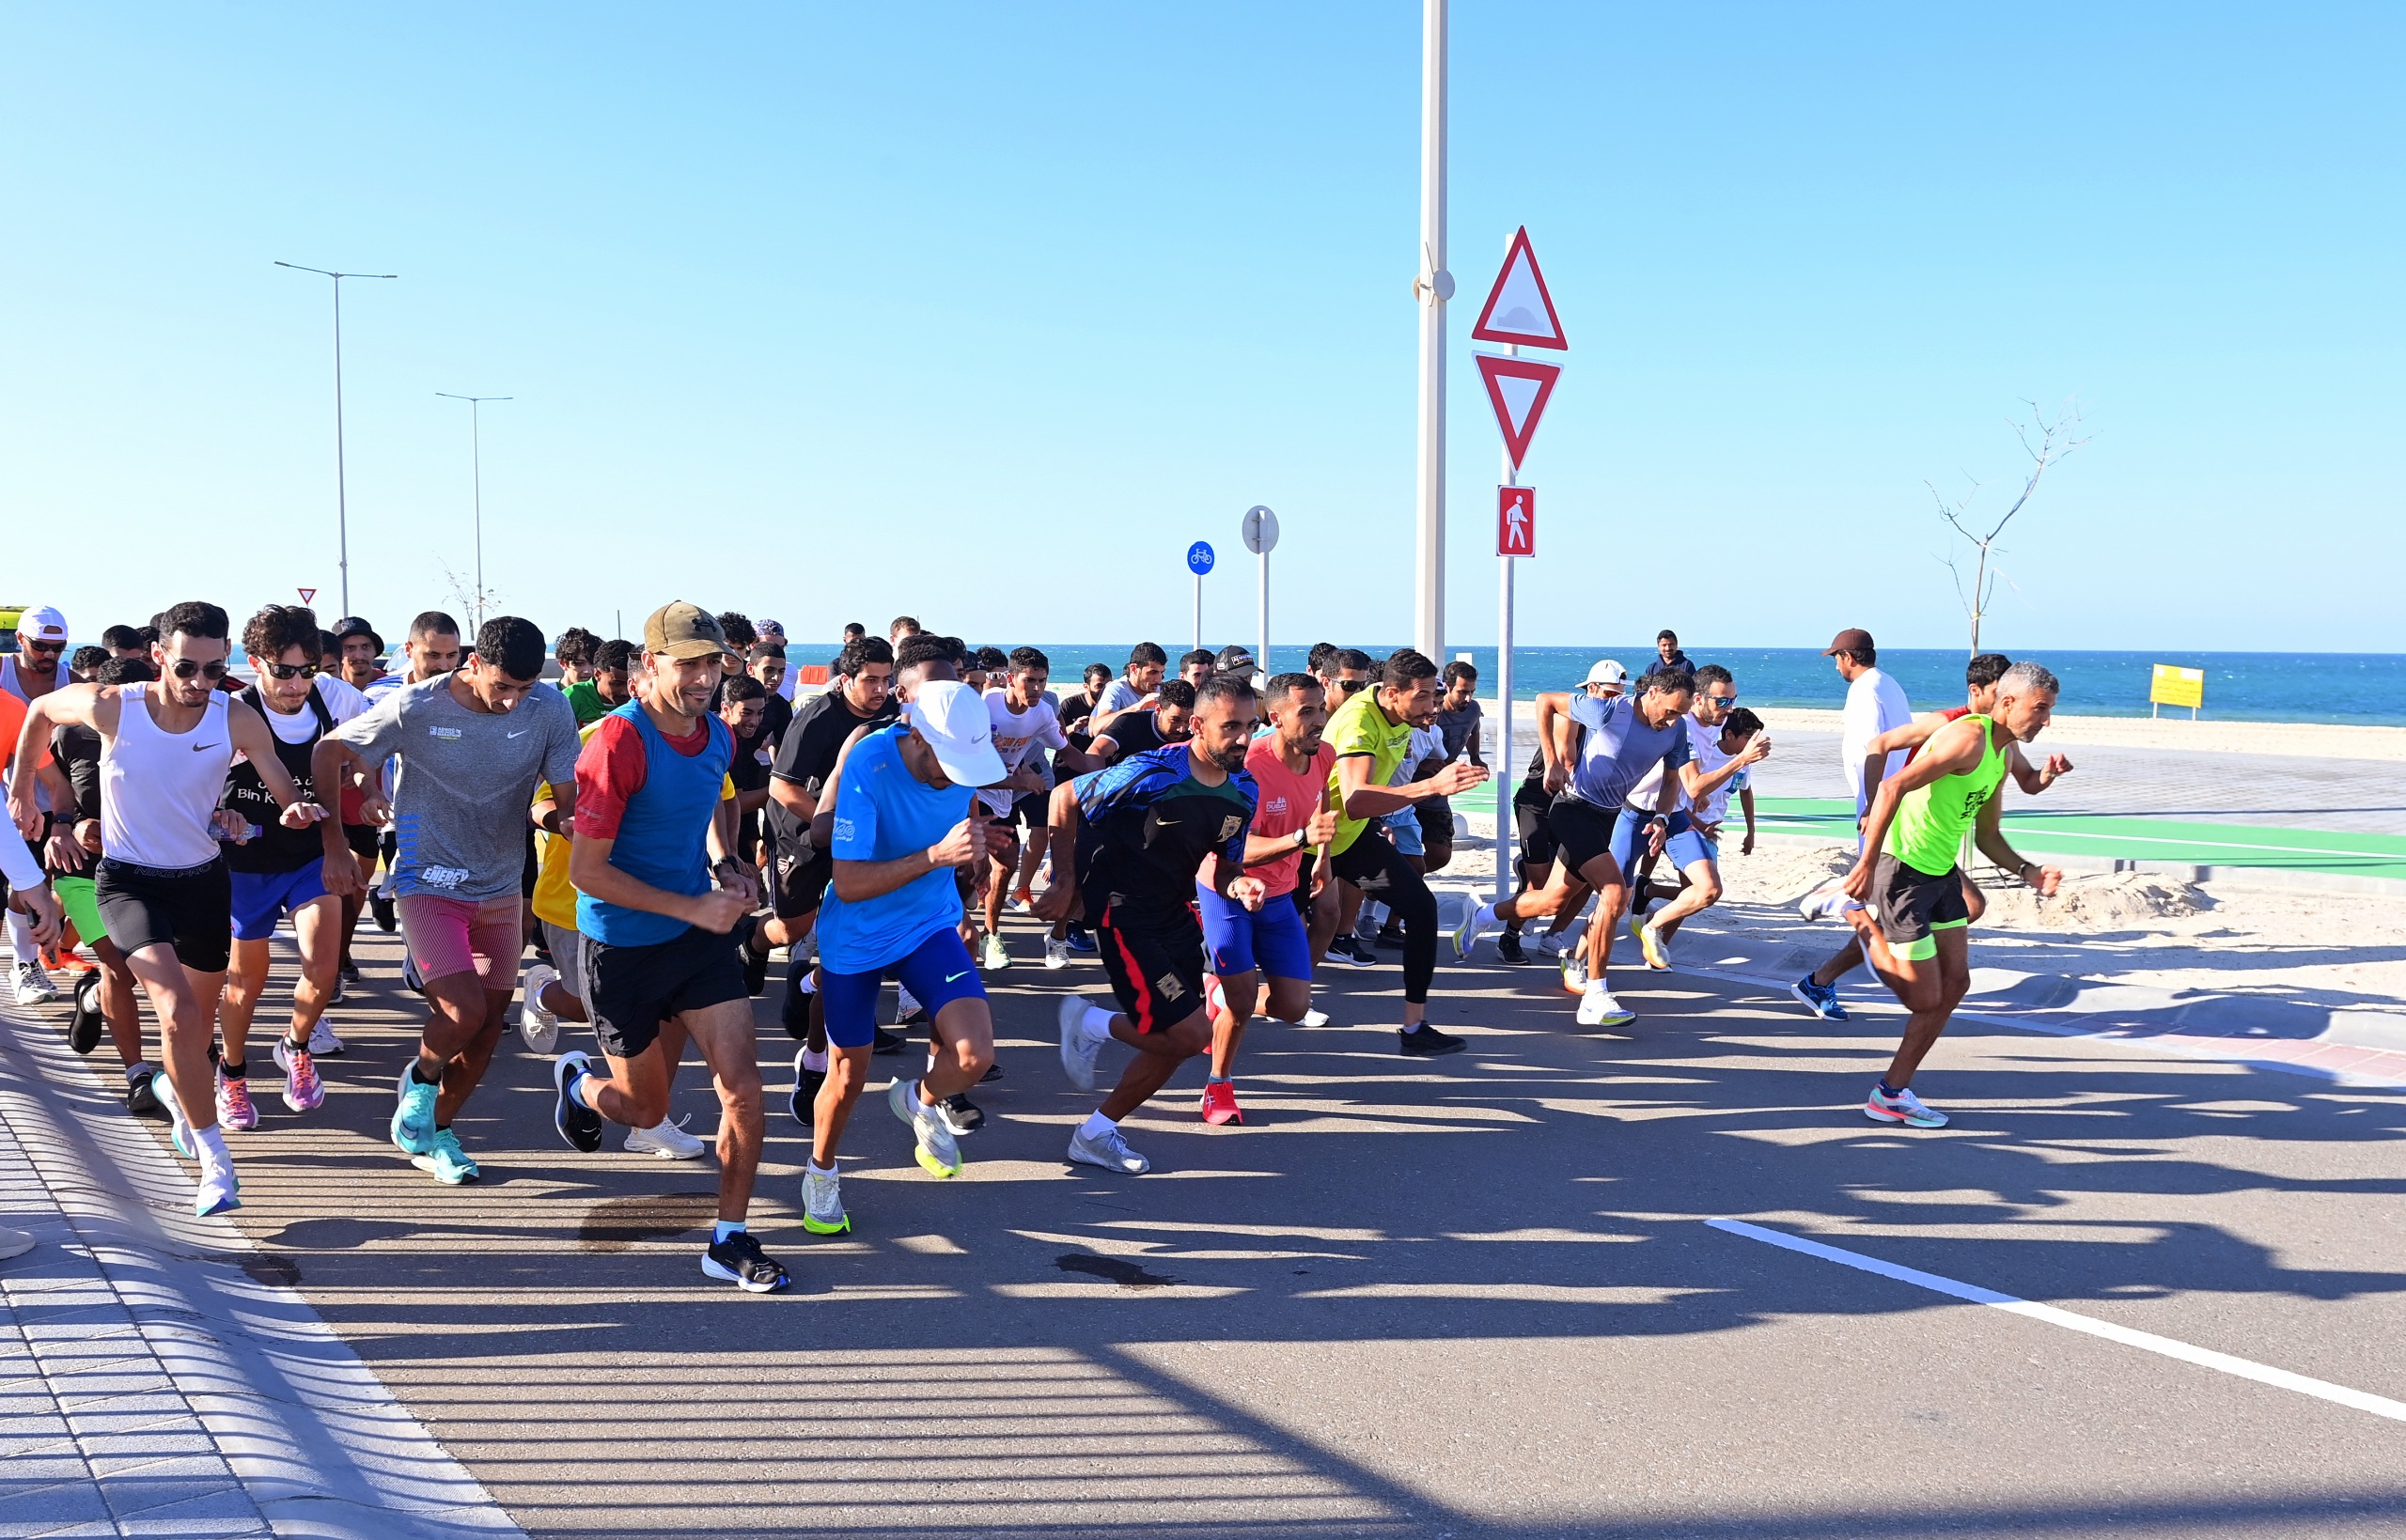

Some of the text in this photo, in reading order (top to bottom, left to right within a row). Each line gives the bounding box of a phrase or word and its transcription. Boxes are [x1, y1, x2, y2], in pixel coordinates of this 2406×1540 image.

[237, 788, 261, 801] Bin
[133, 863, 212, 879] NIKE PRO
[421, 866, 470, 884] ENERGY
